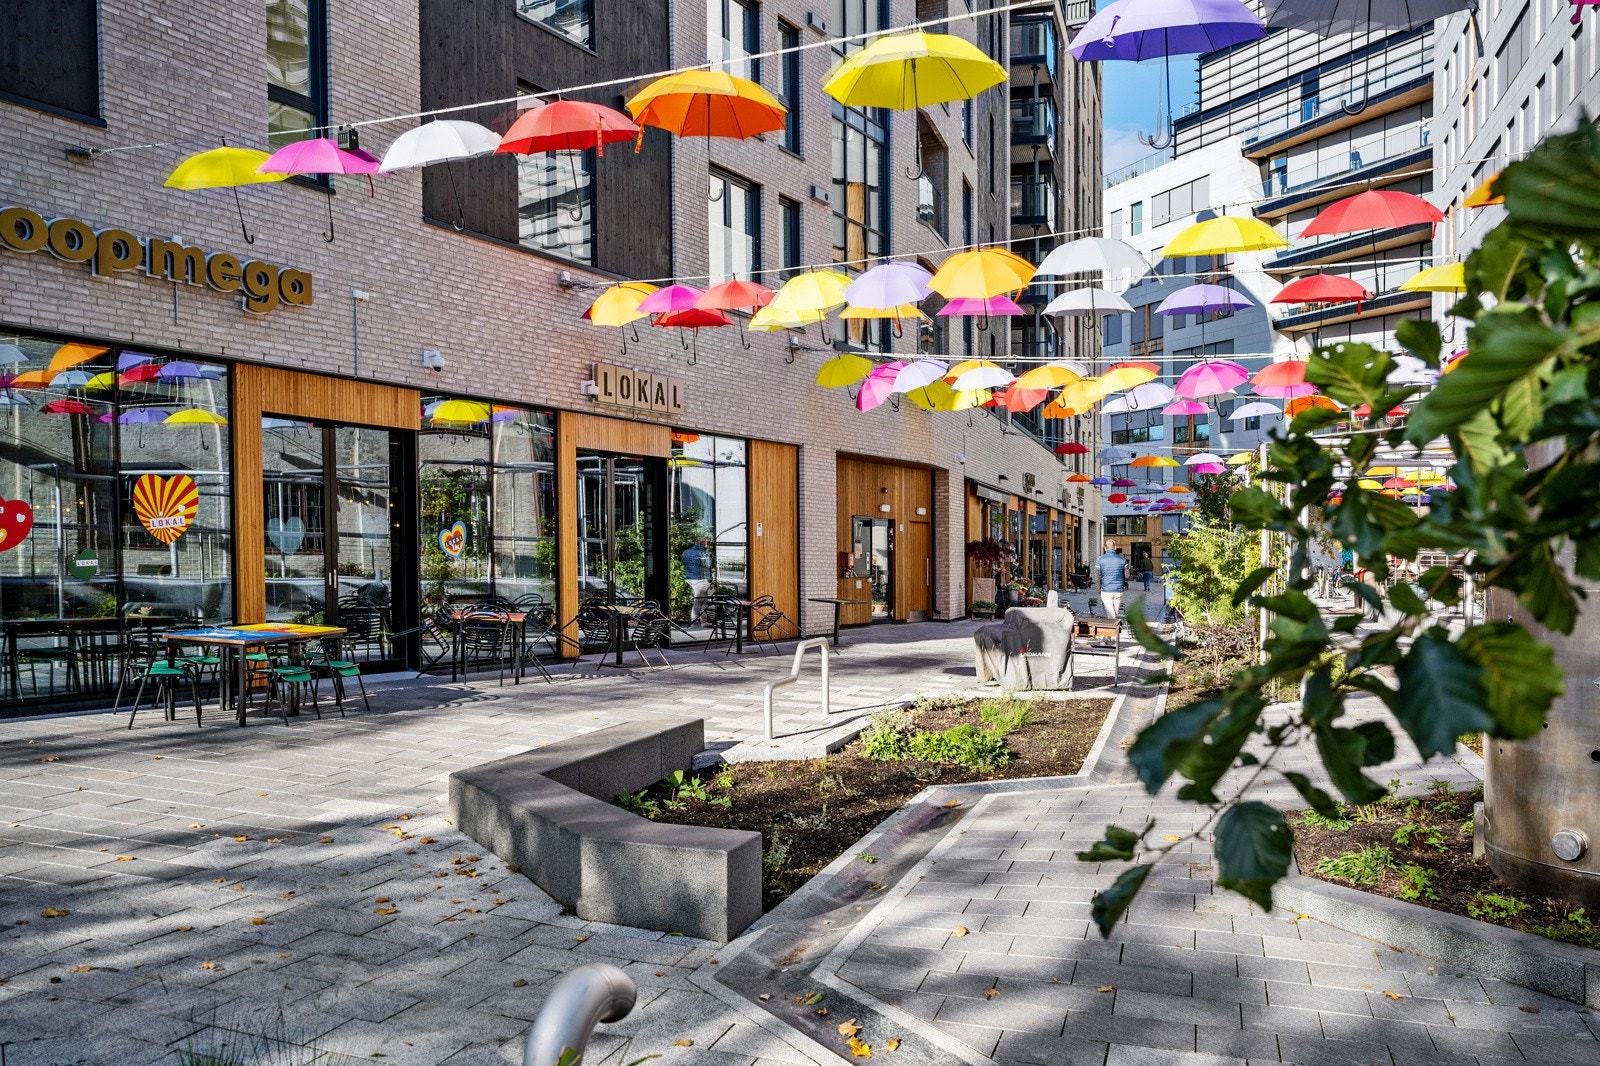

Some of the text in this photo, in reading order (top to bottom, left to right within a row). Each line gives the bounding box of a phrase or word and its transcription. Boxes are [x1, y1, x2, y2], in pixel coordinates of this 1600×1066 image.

[0, 207, 313, 314] oopmega
[603, 371, 681, 409] LOKAL
[151, 517, 185, 528] LOKAL
[854, 521, 863, 537] 17
[445, 535, 463, 548] LOKAL
